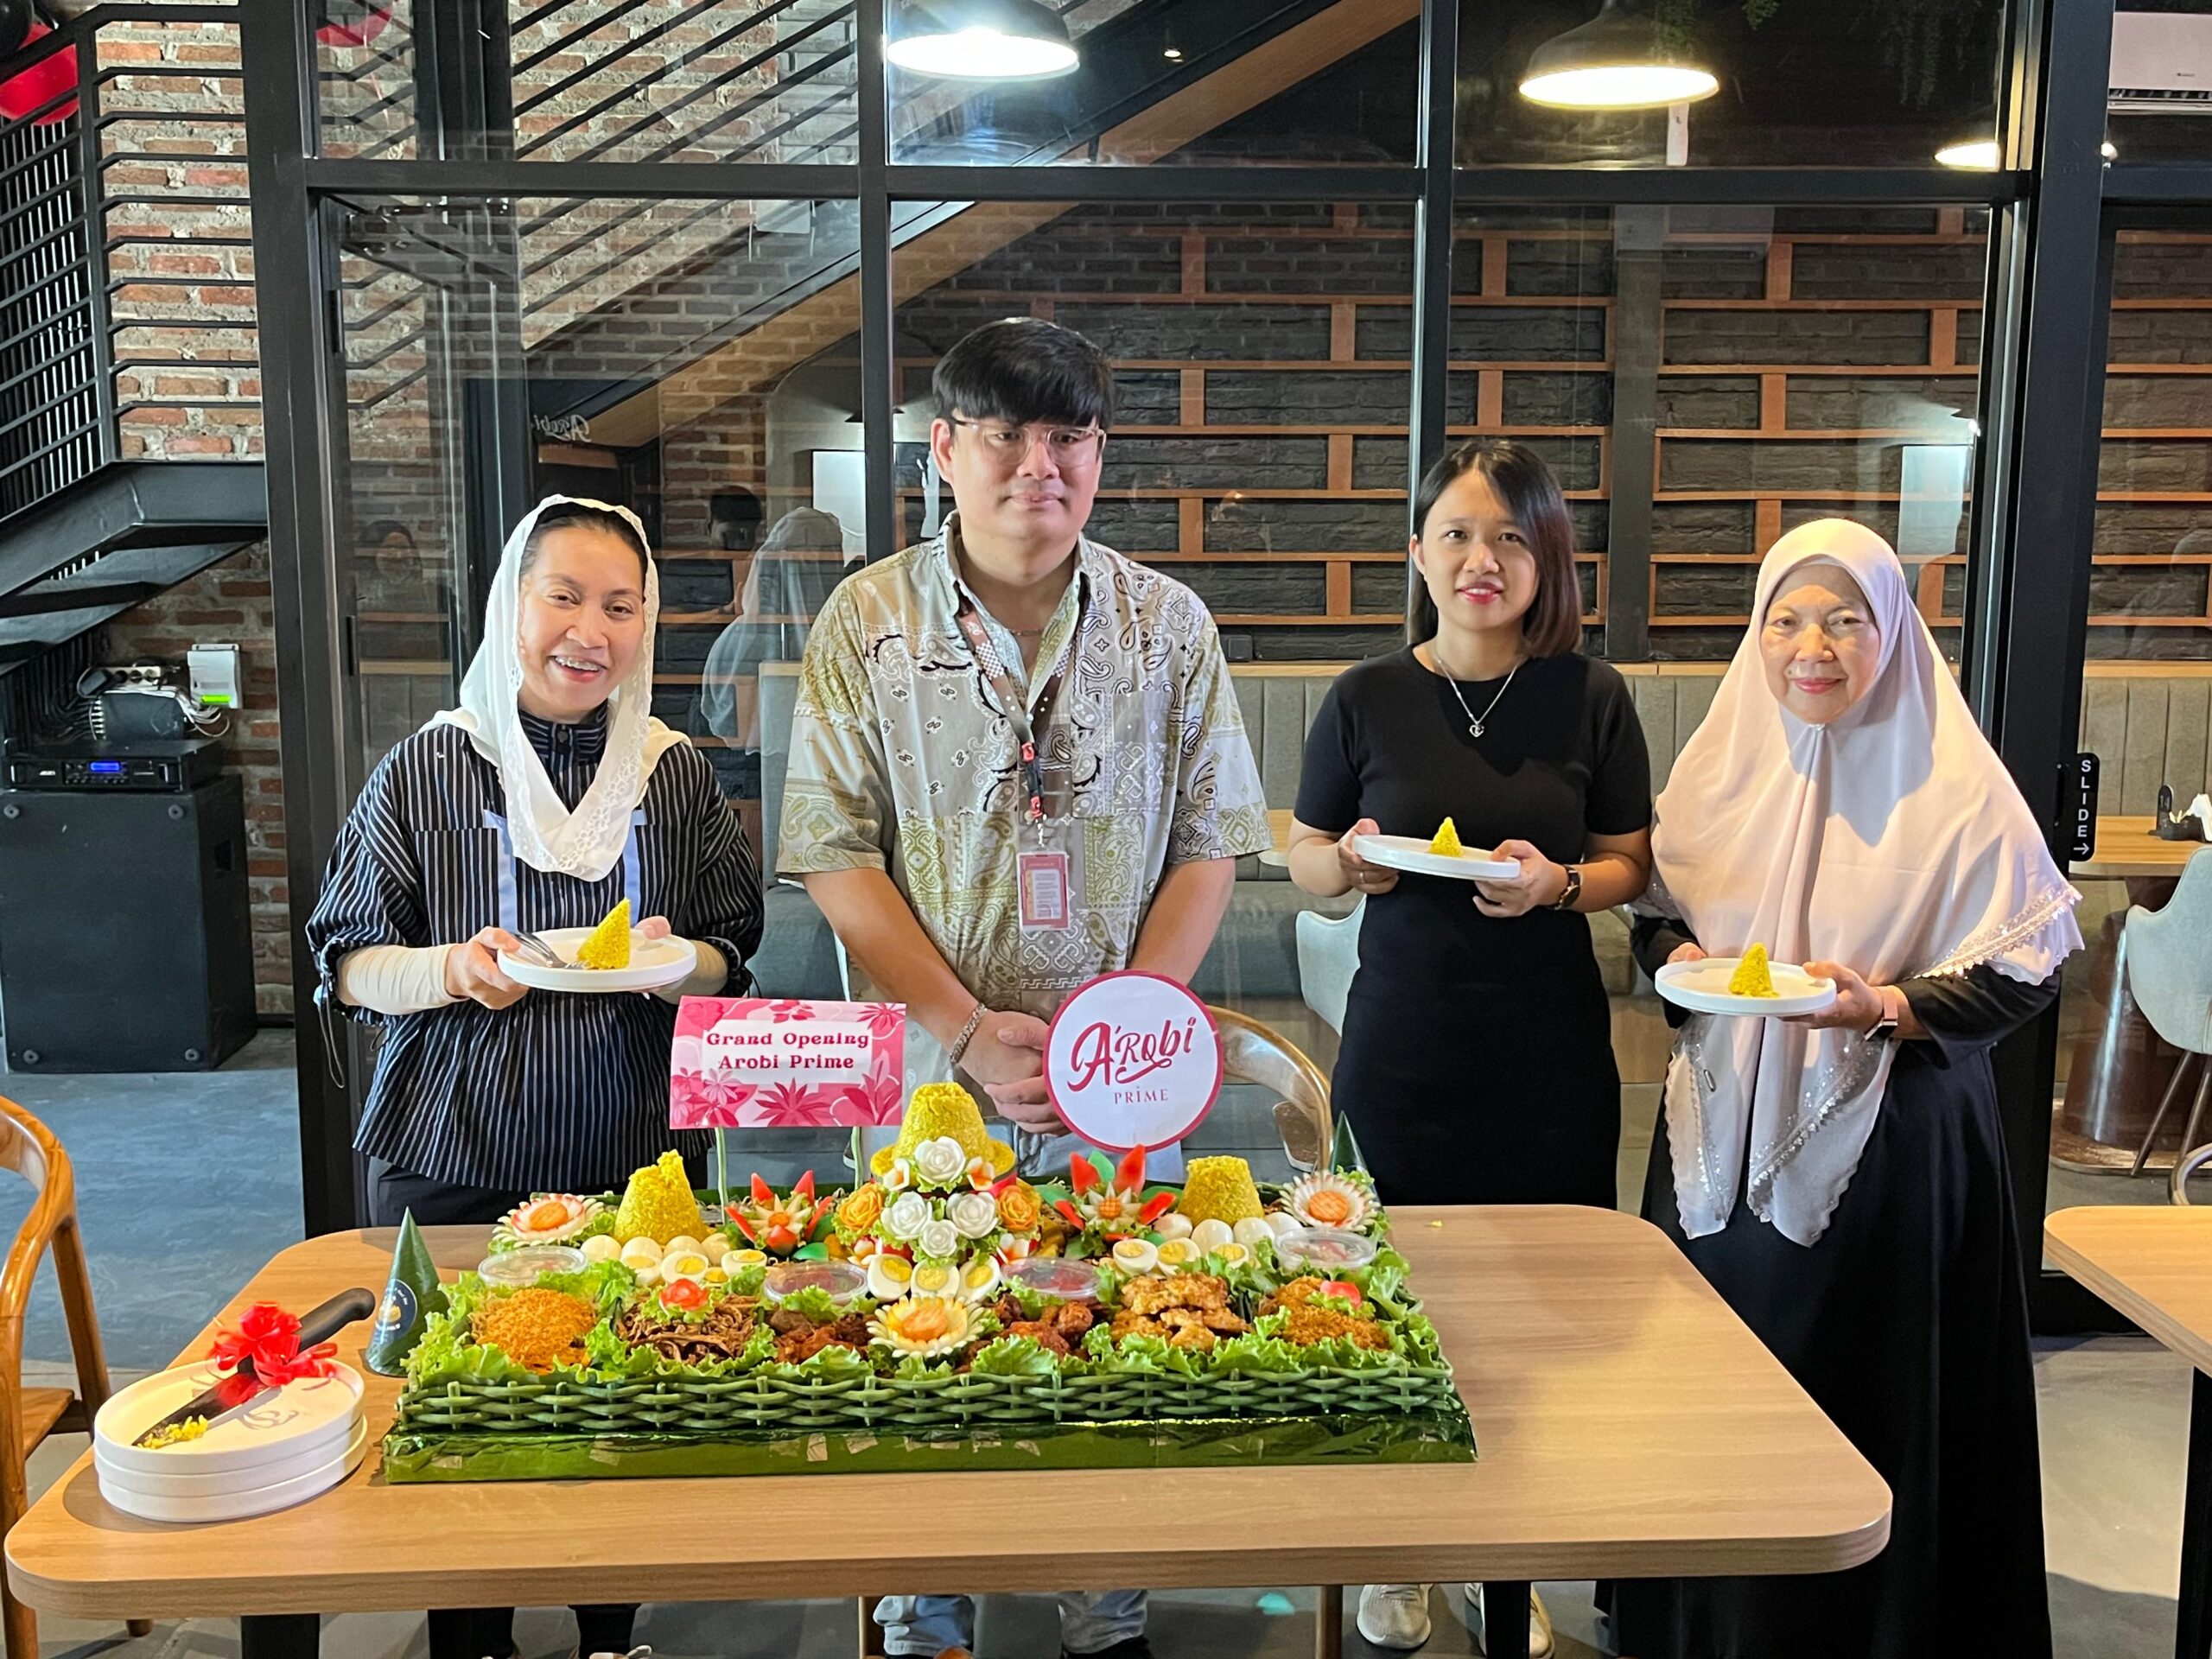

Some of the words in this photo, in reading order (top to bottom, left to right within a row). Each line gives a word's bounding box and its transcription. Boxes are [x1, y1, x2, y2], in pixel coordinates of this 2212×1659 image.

[2077, 760, 2091, 837] SLIDE
[706, 1033, 772, 1046] Grand
[783, 1032, 869, 1048] Opening
[718, 1054, 779, 1069] Arobi
[790, 1054, 854, 1069] Prime
